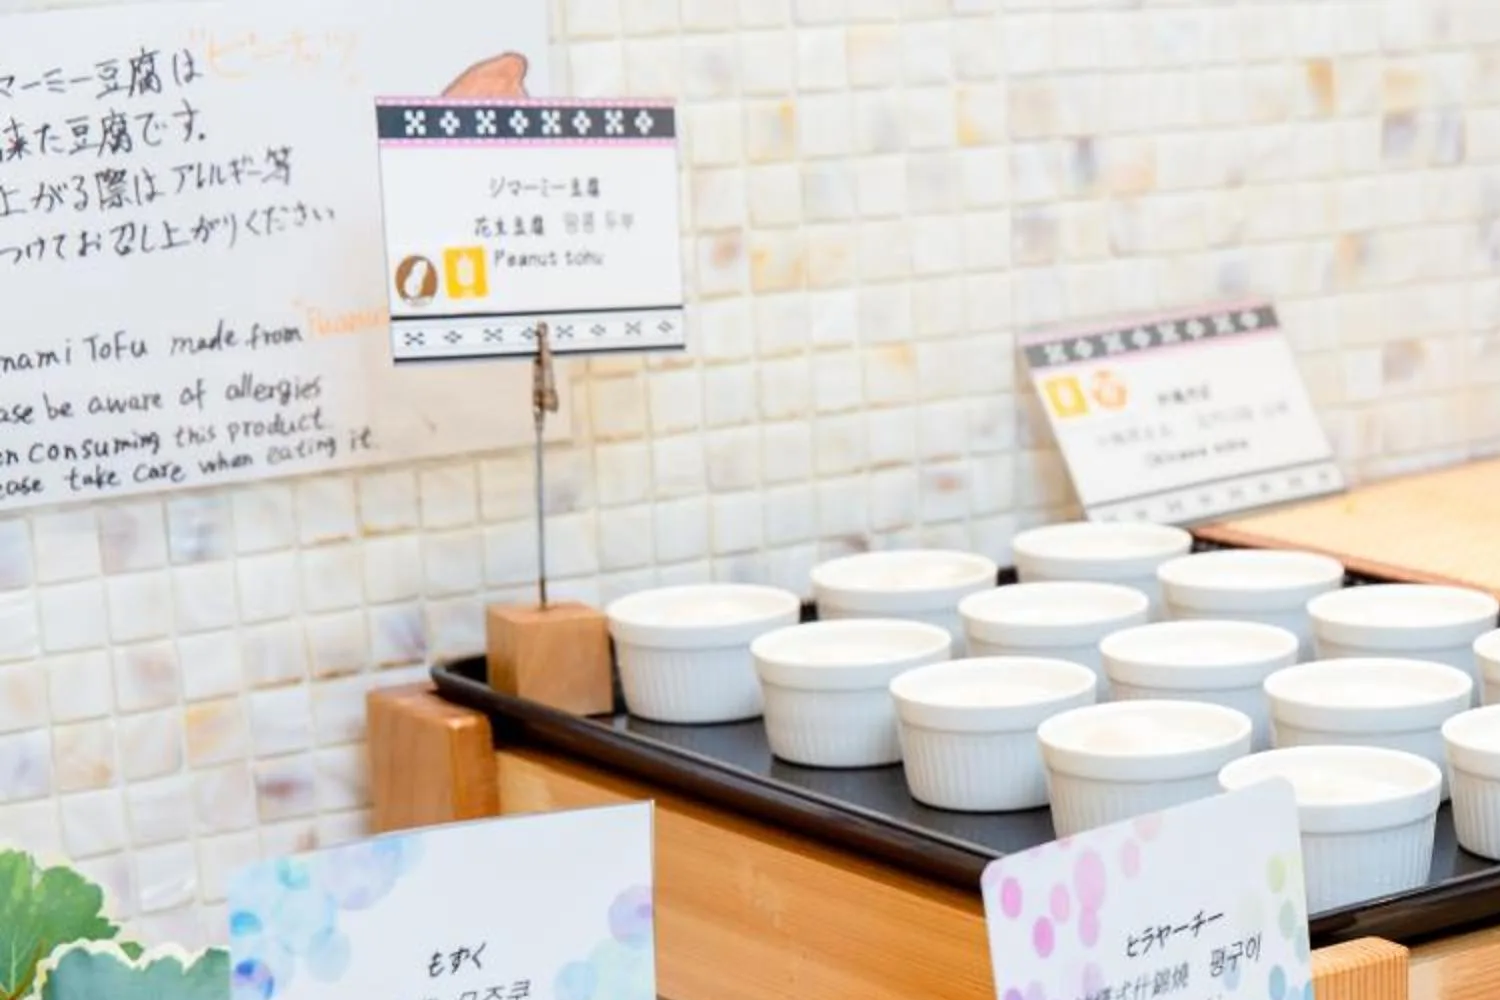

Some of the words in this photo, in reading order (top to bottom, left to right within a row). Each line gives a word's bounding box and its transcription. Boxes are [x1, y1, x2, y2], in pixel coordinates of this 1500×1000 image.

[170, 319, 236, 356] made
[246, 321, 304, 351] from
[43, 391, 73, 421] be
[88, 392, 163, 415] aware
[179, 378, 206, 409] of
[225, 373, 321, 405] allergies
[175, 424, 217, 449] this
[65, 465, 122, 491] take
[199, 450, 254, 475] when
[266, 435, 337, 464] eating
[1126, 911, 1224, 958] ヒラヤーチー
[428, 942, 487, 978] もずく
